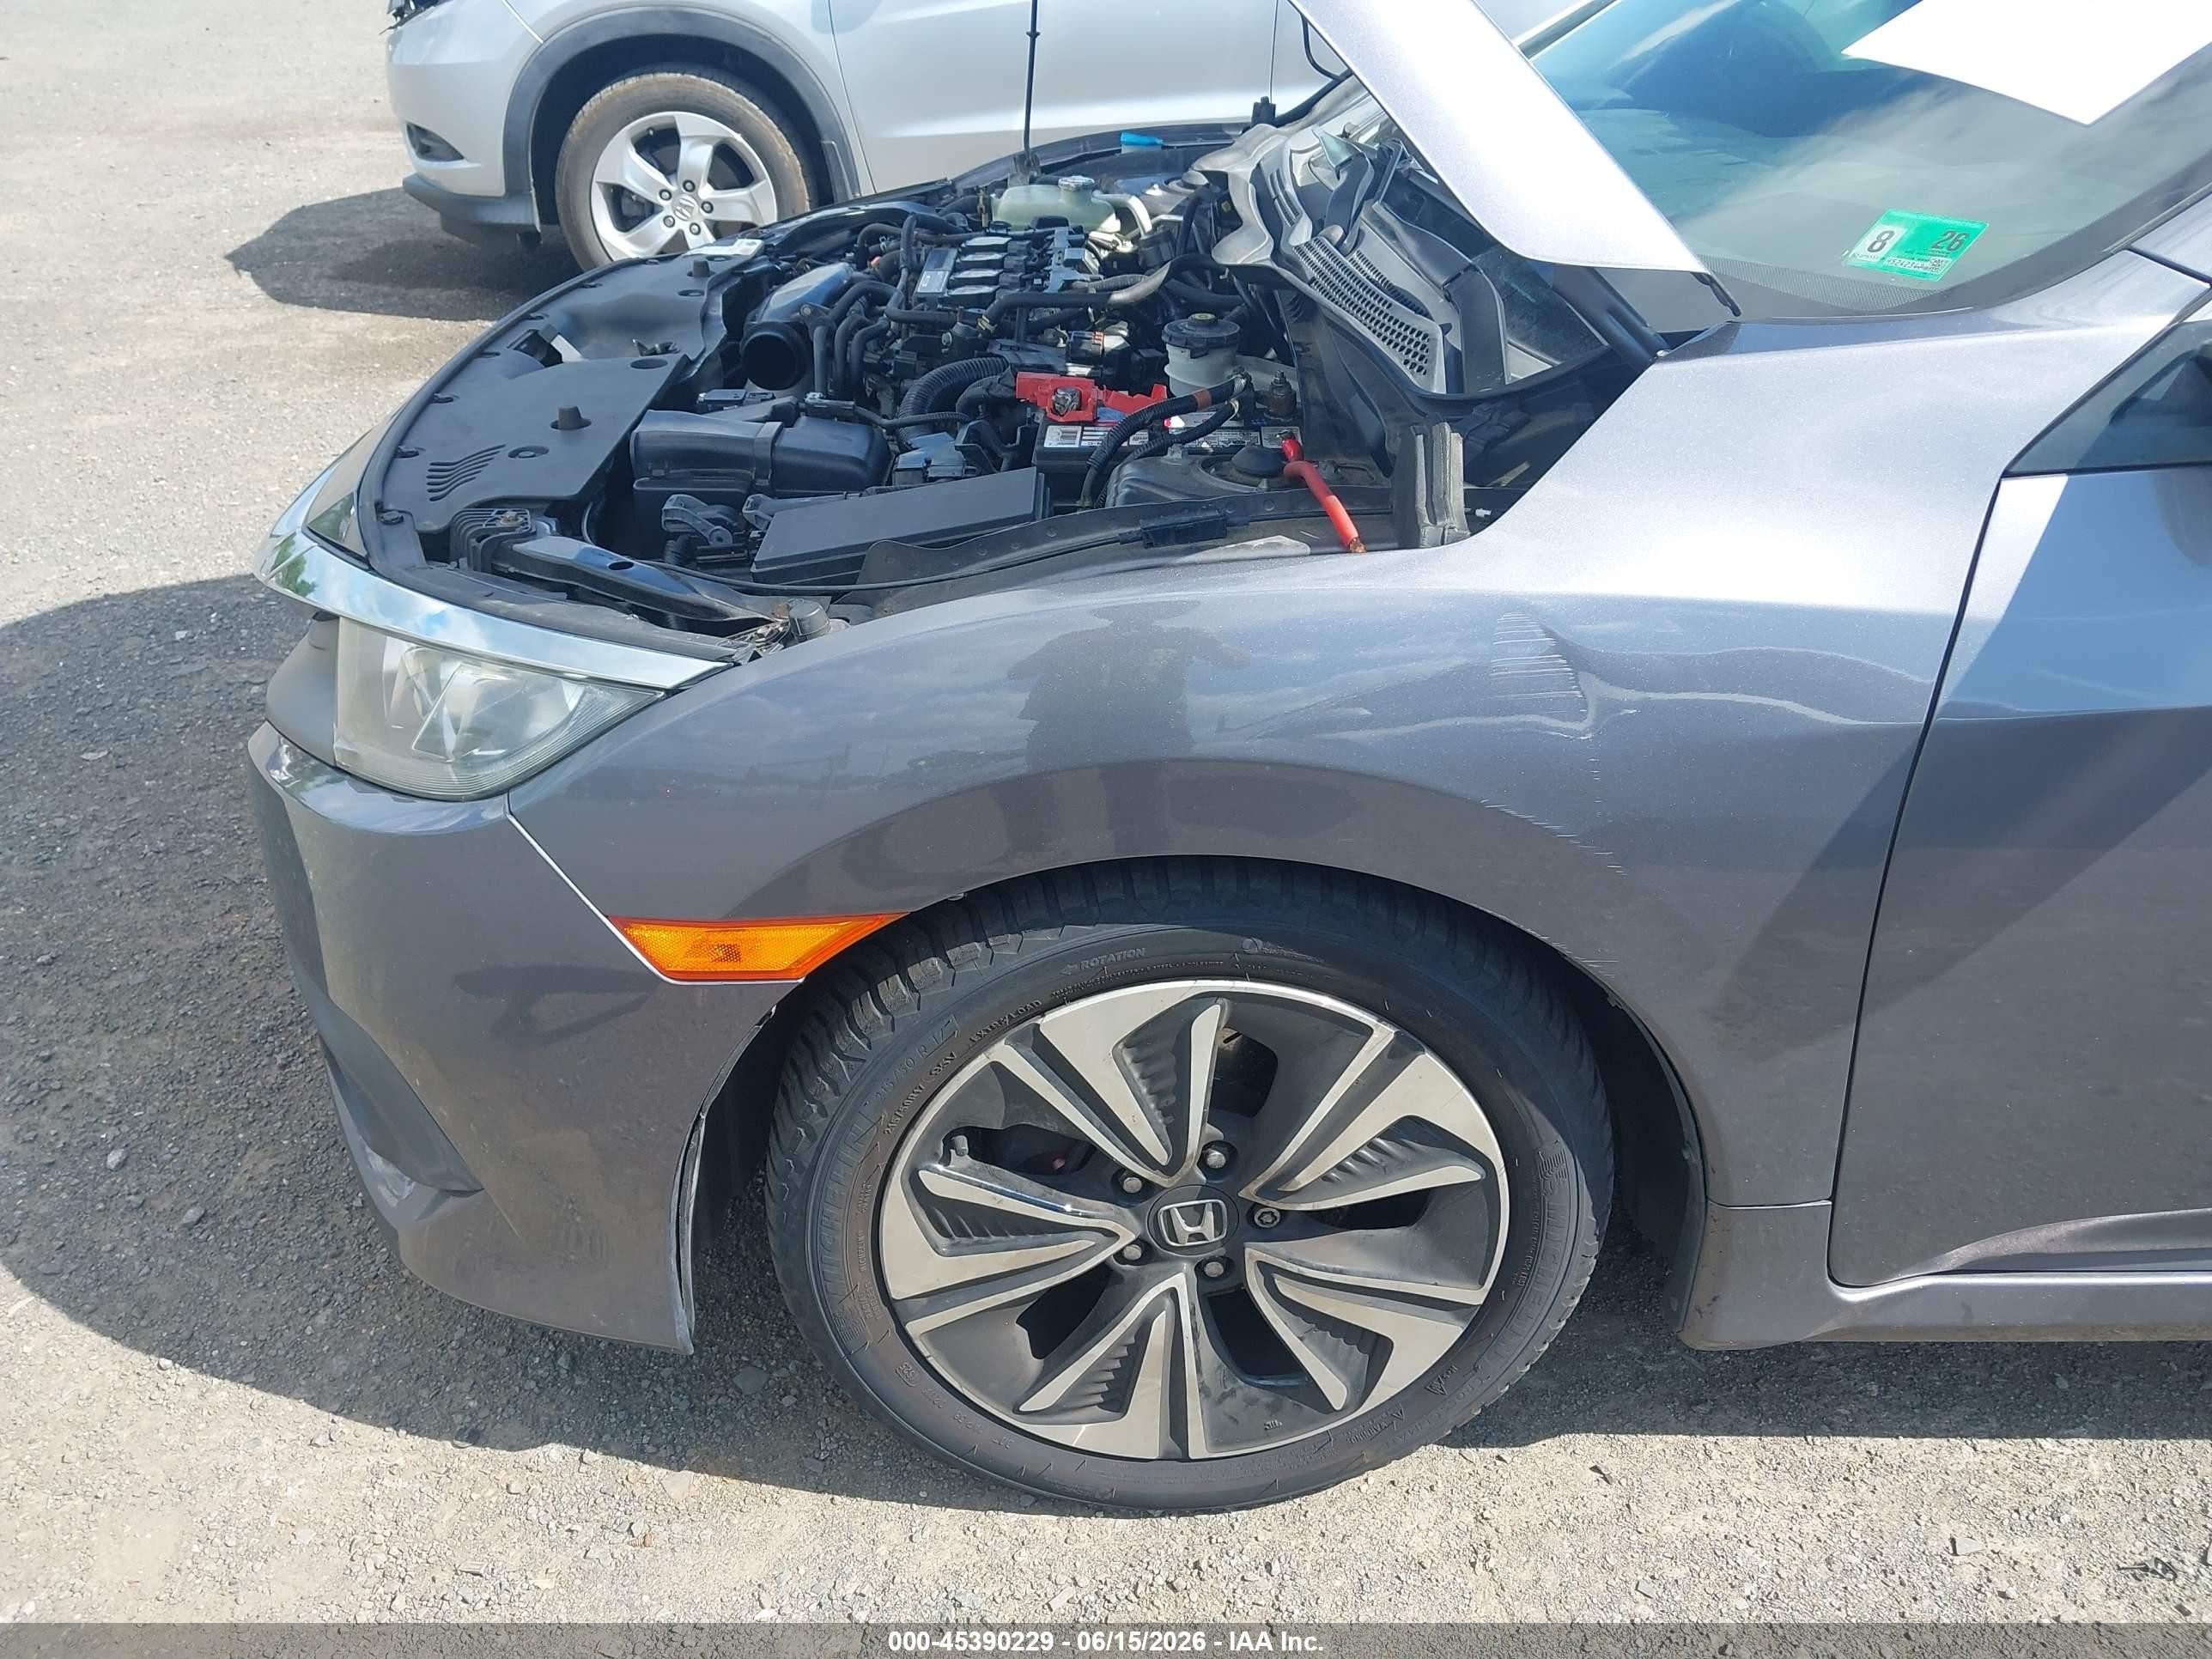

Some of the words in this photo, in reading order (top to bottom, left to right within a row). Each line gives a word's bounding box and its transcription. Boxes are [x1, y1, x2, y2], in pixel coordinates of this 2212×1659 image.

[1867, 230, 1894, 252] 8
[1932, 231, 1969, 251] 26
[1077, 947, 1147, 969] ROTATION
[1008, 998, 1042, 1018] LOAD
